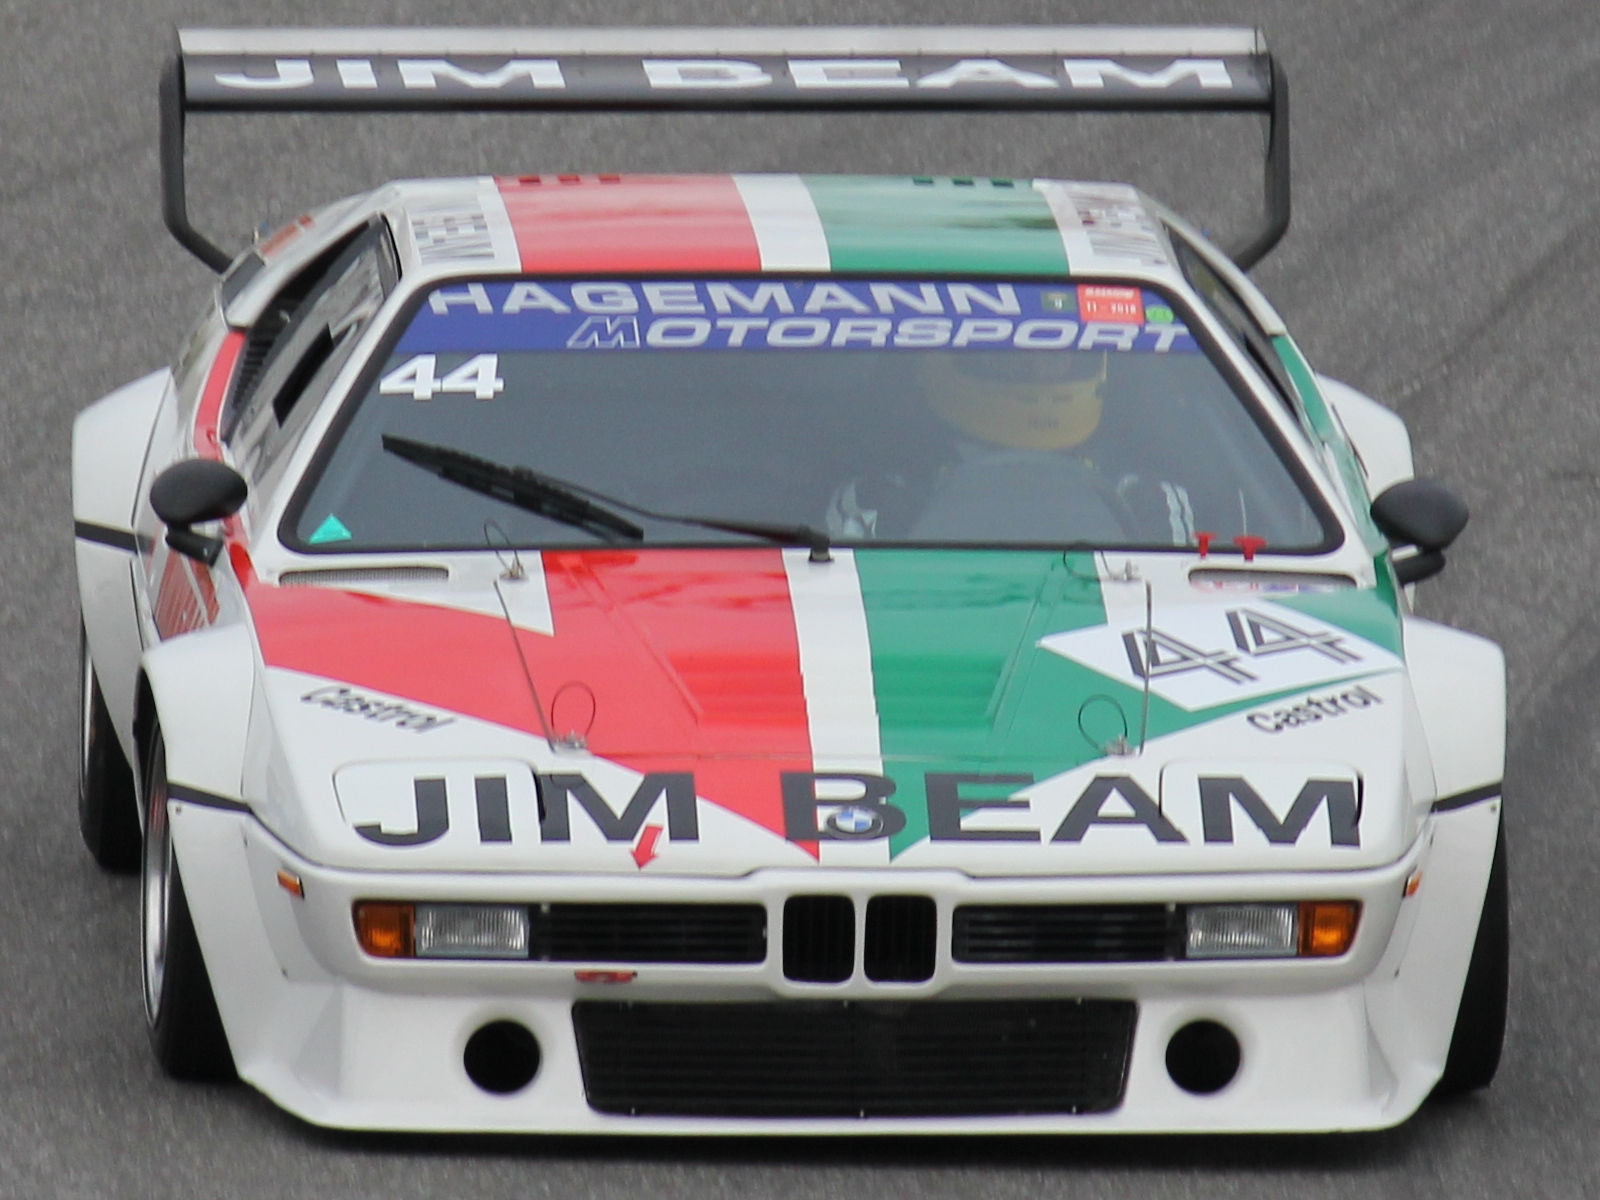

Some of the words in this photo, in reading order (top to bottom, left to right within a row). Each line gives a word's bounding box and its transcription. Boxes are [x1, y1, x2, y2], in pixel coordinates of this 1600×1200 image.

[214, 59, 566, 89] JIM
[642, 59, 1233, 89] BEAM
[428, 282, 1022, 315] HAGEMANN
[566, 315, 1190, 353] MOTORSPORT
[379, 353, 504, 400] 44
[1121, 608, 1363, 685] 44
[301, 686, 455, 735] Castrol
[1246, 685, 1383, 734] Castrol
[353, 772, 700, 846] JIM
[779, 772, 1361, 848] BEAM
